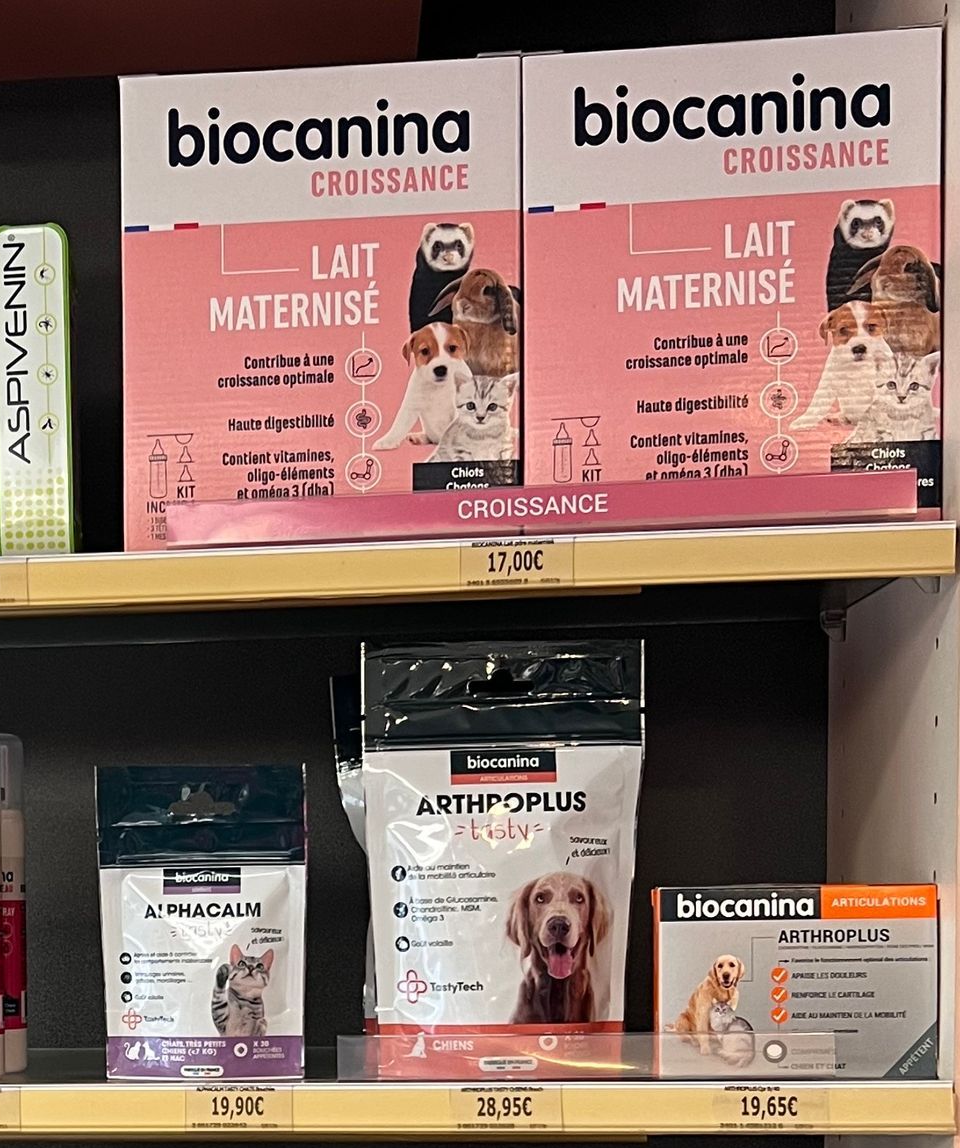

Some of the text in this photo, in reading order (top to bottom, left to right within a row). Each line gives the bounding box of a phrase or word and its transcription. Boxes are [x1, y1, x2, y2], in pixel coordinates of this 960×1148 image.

[574, 72, 891, 147] biocanina
[168, 99, 470, 167] biocanina
[311, 164, 469, 197] CROISSANCE
[311, 243, 380, 280] LAIT
[209, 281, 380, 332] MATERNISÉ
[244, 353, 334, 370] Contribue à une
[218, 369, 334, 389] croissance optimale
[228, 414, 334, 432] Haute digestibilité
[247, 465, 335, 484] oligo-éléments
[451, 465, 484, 480] Chiots
[457, 493, 609, 521] CROISSANCE
[487, 550, 544, 576] 17,00€
[467, 755, 539, 770] biocanina
[416, 791, 587, 816] ARTHROPLUS
[175, 872, 229, 883] biocanina
[676, 892, 927, 919] biocanina ARTICULATIONS
[778, 929, 890, 944] ARTHROPLUS
[430, 982, 483, 994] TastyTech
[898, 1037, 934, 1075] APPÉTENT
[211, 1096, 264, 1118] 19,90€
[476, 1096, 532, 1118] 28,95€
[740, 1096, 798, 1118] 19,65€
